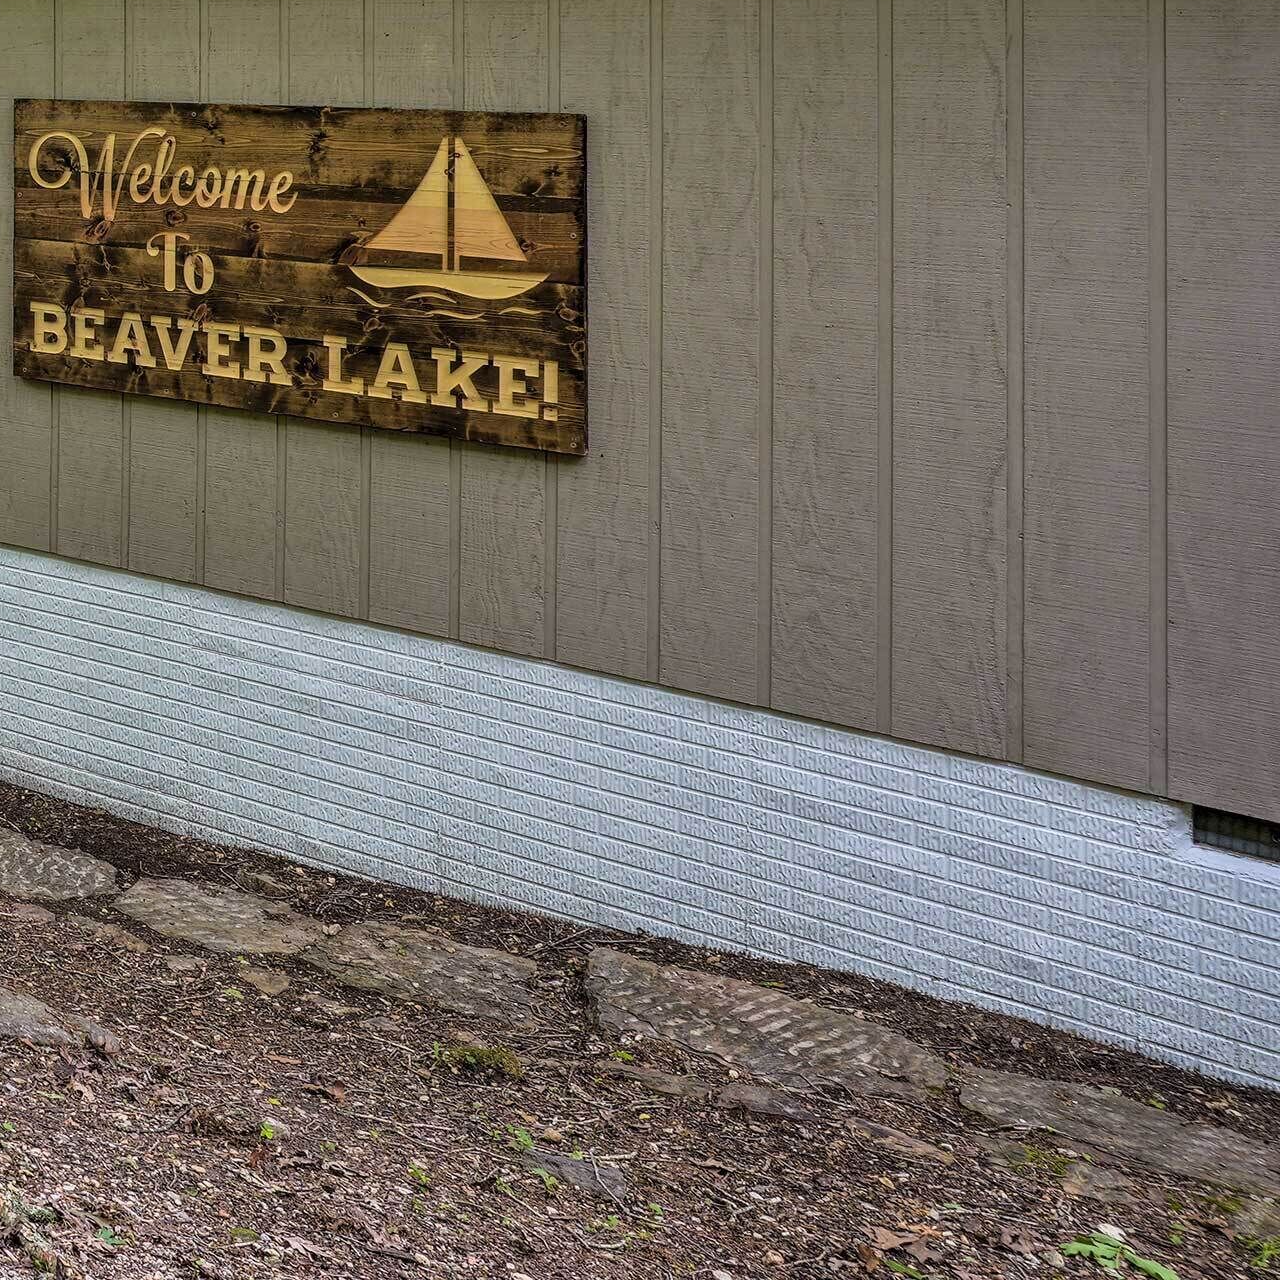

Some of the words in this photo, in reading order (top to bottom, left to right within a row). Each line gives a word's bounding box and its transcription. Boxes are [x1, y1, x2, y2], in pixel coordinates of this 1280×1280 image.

[28, 128, 298, 220] Welcome
[146, 232, 215, 295] To
[30, 302, 293, 386] BEAVER
[323, 335, 559, 421] LAKE!
